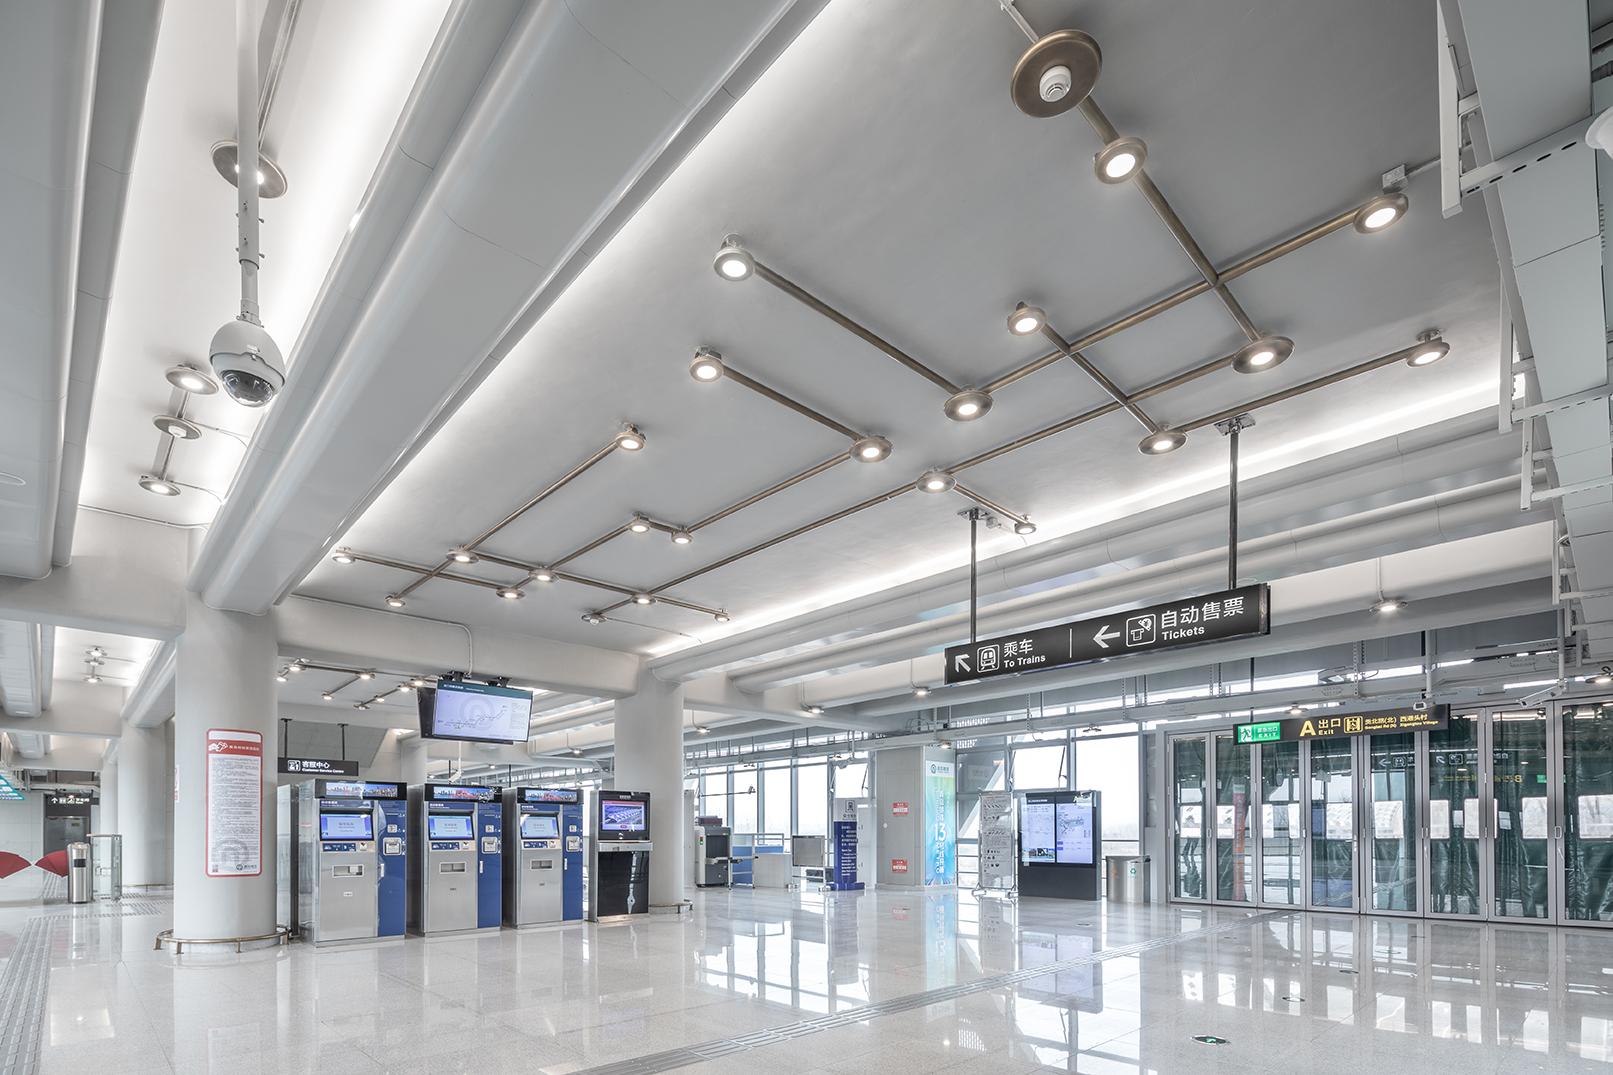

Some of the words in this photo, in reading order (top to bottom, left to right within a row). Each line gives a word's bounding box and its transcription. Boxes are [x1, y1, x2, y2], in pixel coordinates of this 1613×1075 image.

[1161, 596, 1244, 629] 自动售票
[1162, 626, 1205, 641] Tickets
[1003, 638, 1033, 657] 乘车
[1004, 659, 1015, 669] To
[1017, 654, 1046, 667] Trains
[1299, 720, 1316, 737] A
[1318, 718, 1341, 729] 出口
[934, 823, 946, 841] 13
